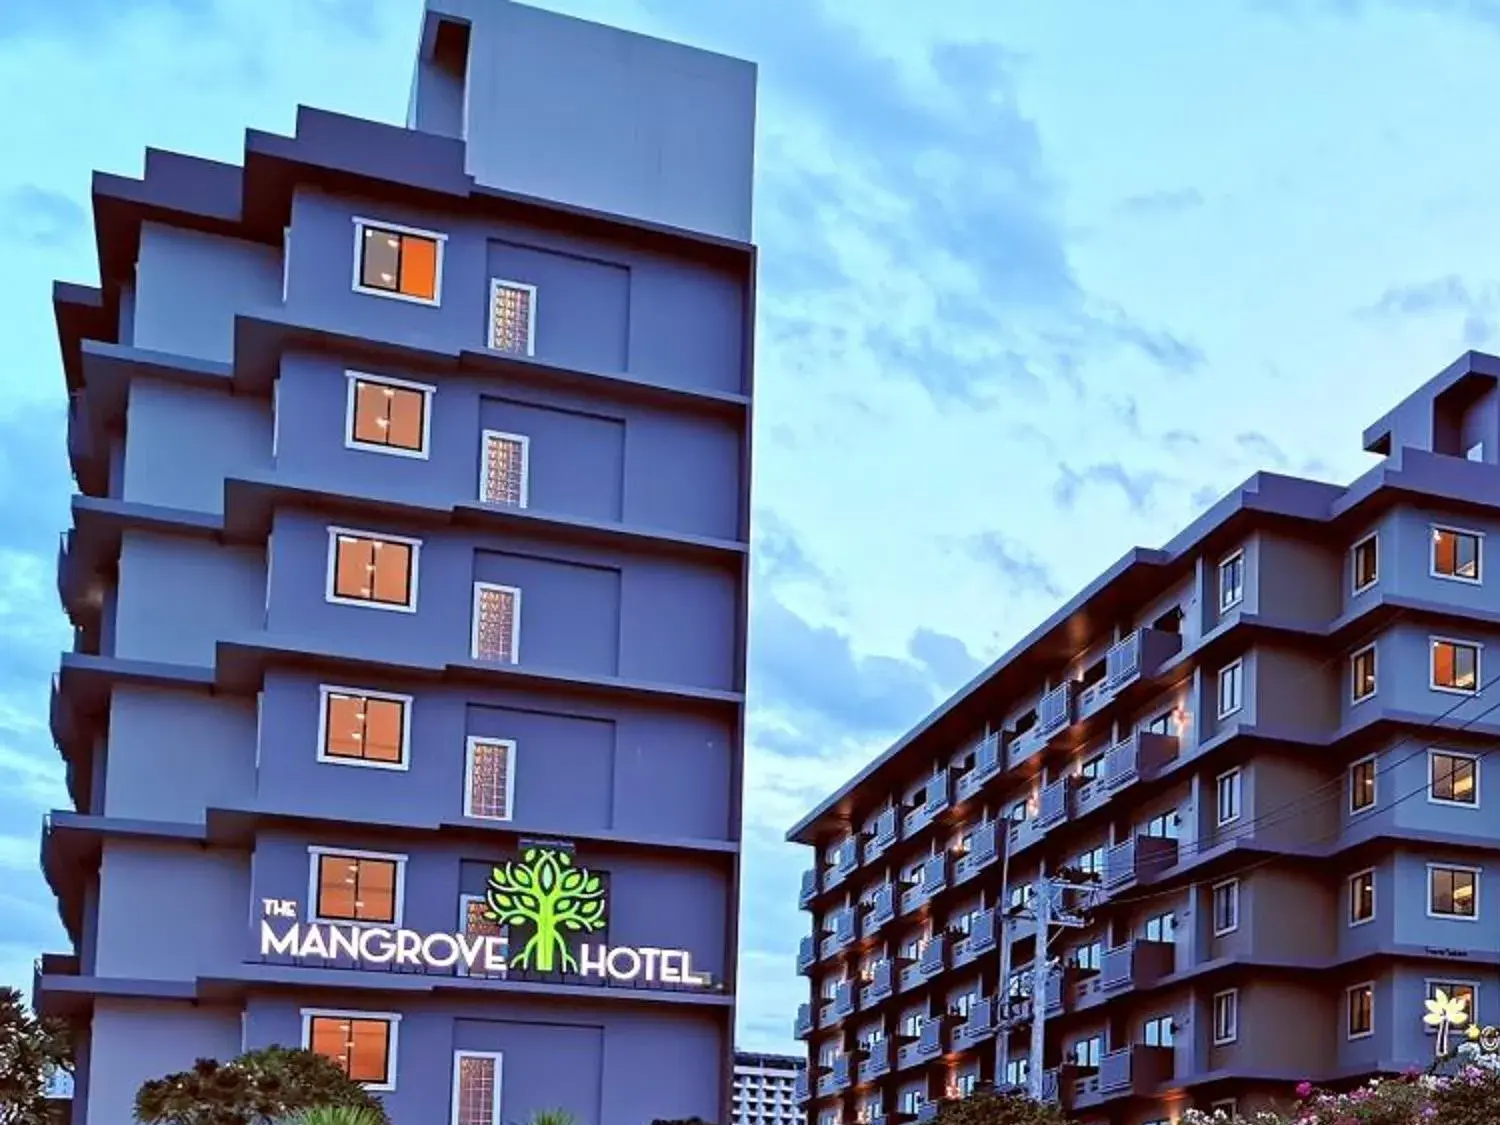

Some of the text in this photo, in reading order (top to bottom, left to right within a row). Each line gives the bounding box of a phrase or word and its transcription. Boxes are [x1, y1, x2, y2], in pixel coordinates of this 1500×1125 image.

[261, 899, 297, 917] THE
[260, 919, 703, 985] MANGROVE HOTEL
